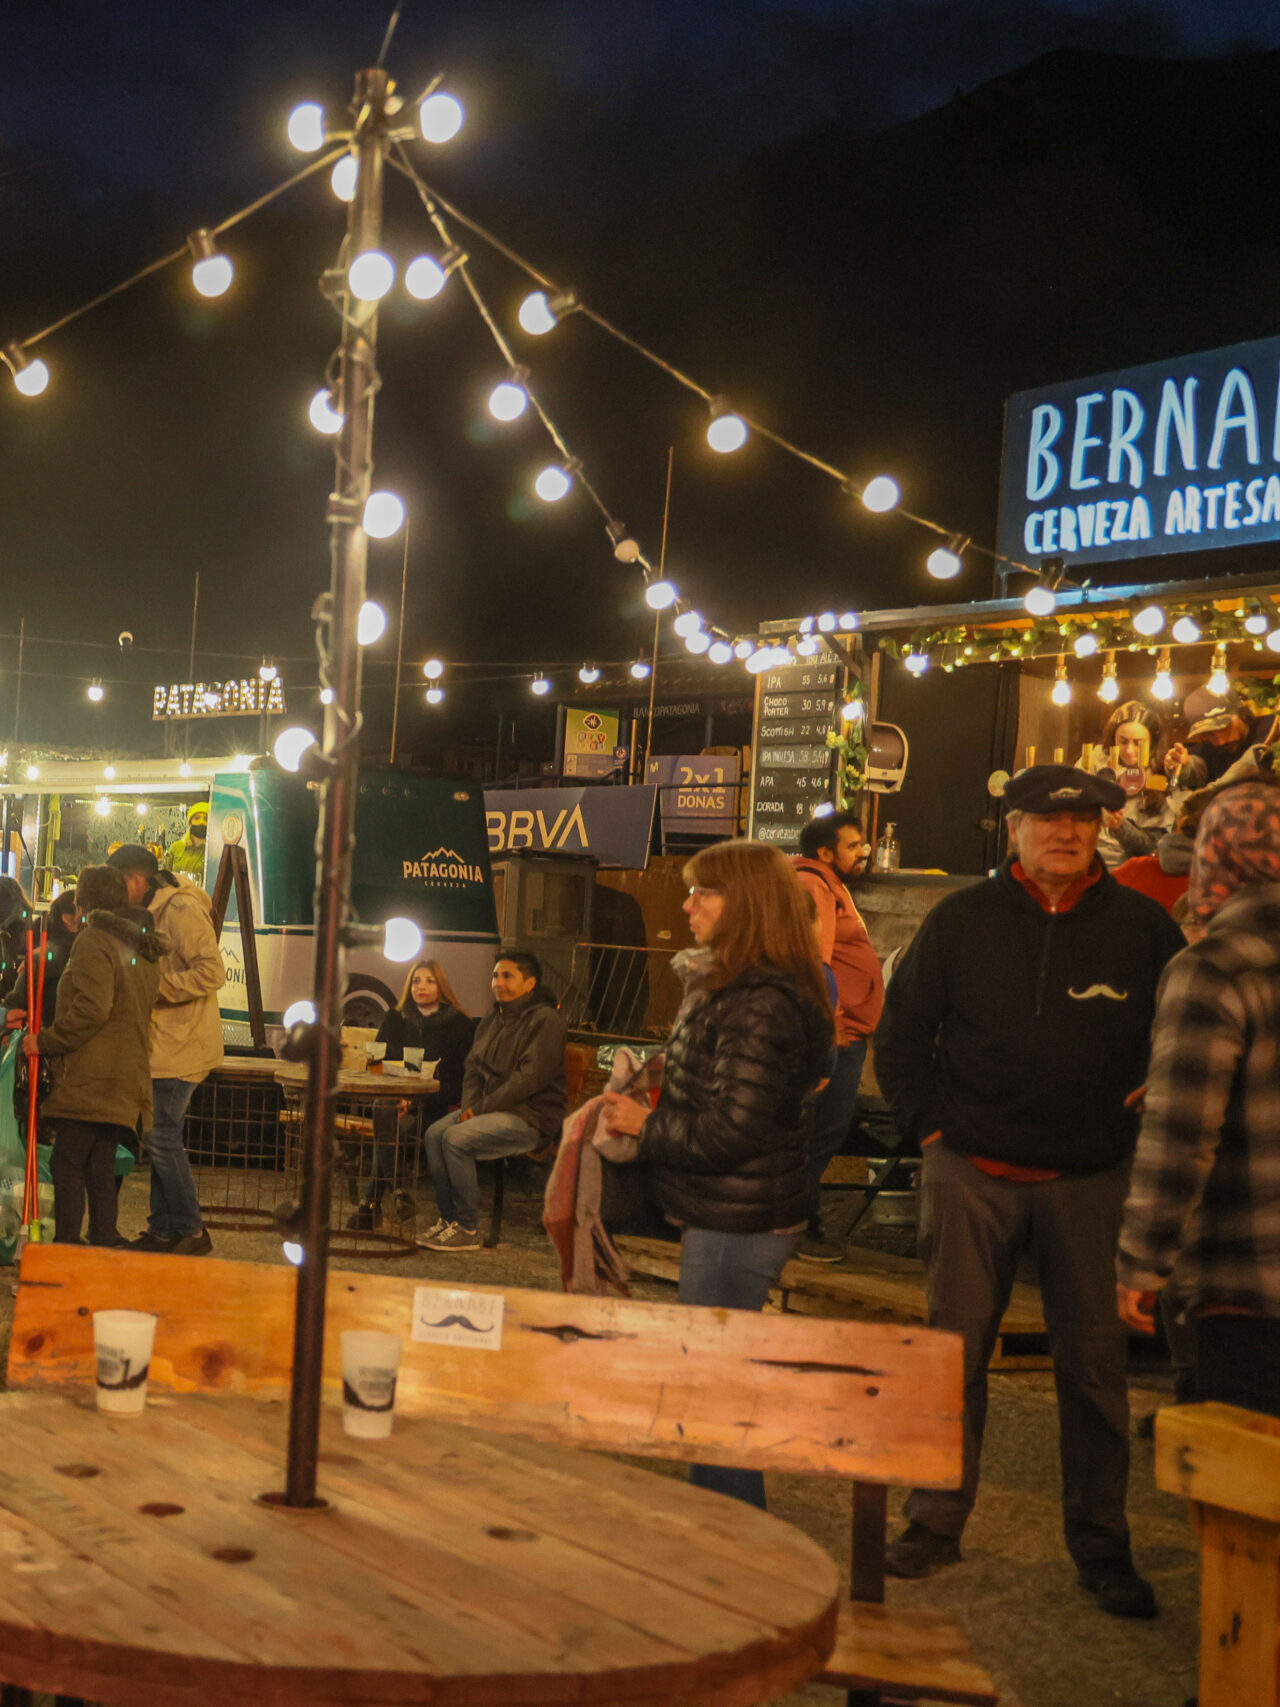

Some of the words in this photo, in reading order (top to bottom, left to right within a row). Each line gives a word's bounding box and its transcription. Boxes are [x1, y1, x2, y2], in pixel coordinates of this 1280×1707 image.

[1024, 494, 1152, 554] CERVEZA
[767, 675, 782, 689] IPA
[801, 674, 811, 686] 55
[763, 697, 788, 708] CHOCO
[801, 699, 812, 711] 30
[800, 725, 811, 735] 22
[679, 766, 726, 794] 2x1
[759, 776, 775, 788] APA
[677, 794, 725, 809] DONAS
[756, 801, 785, 813] DORADA
[485, 803, 589, 851] BBVA
[402, 860, 484, 883] PATAGONIA
